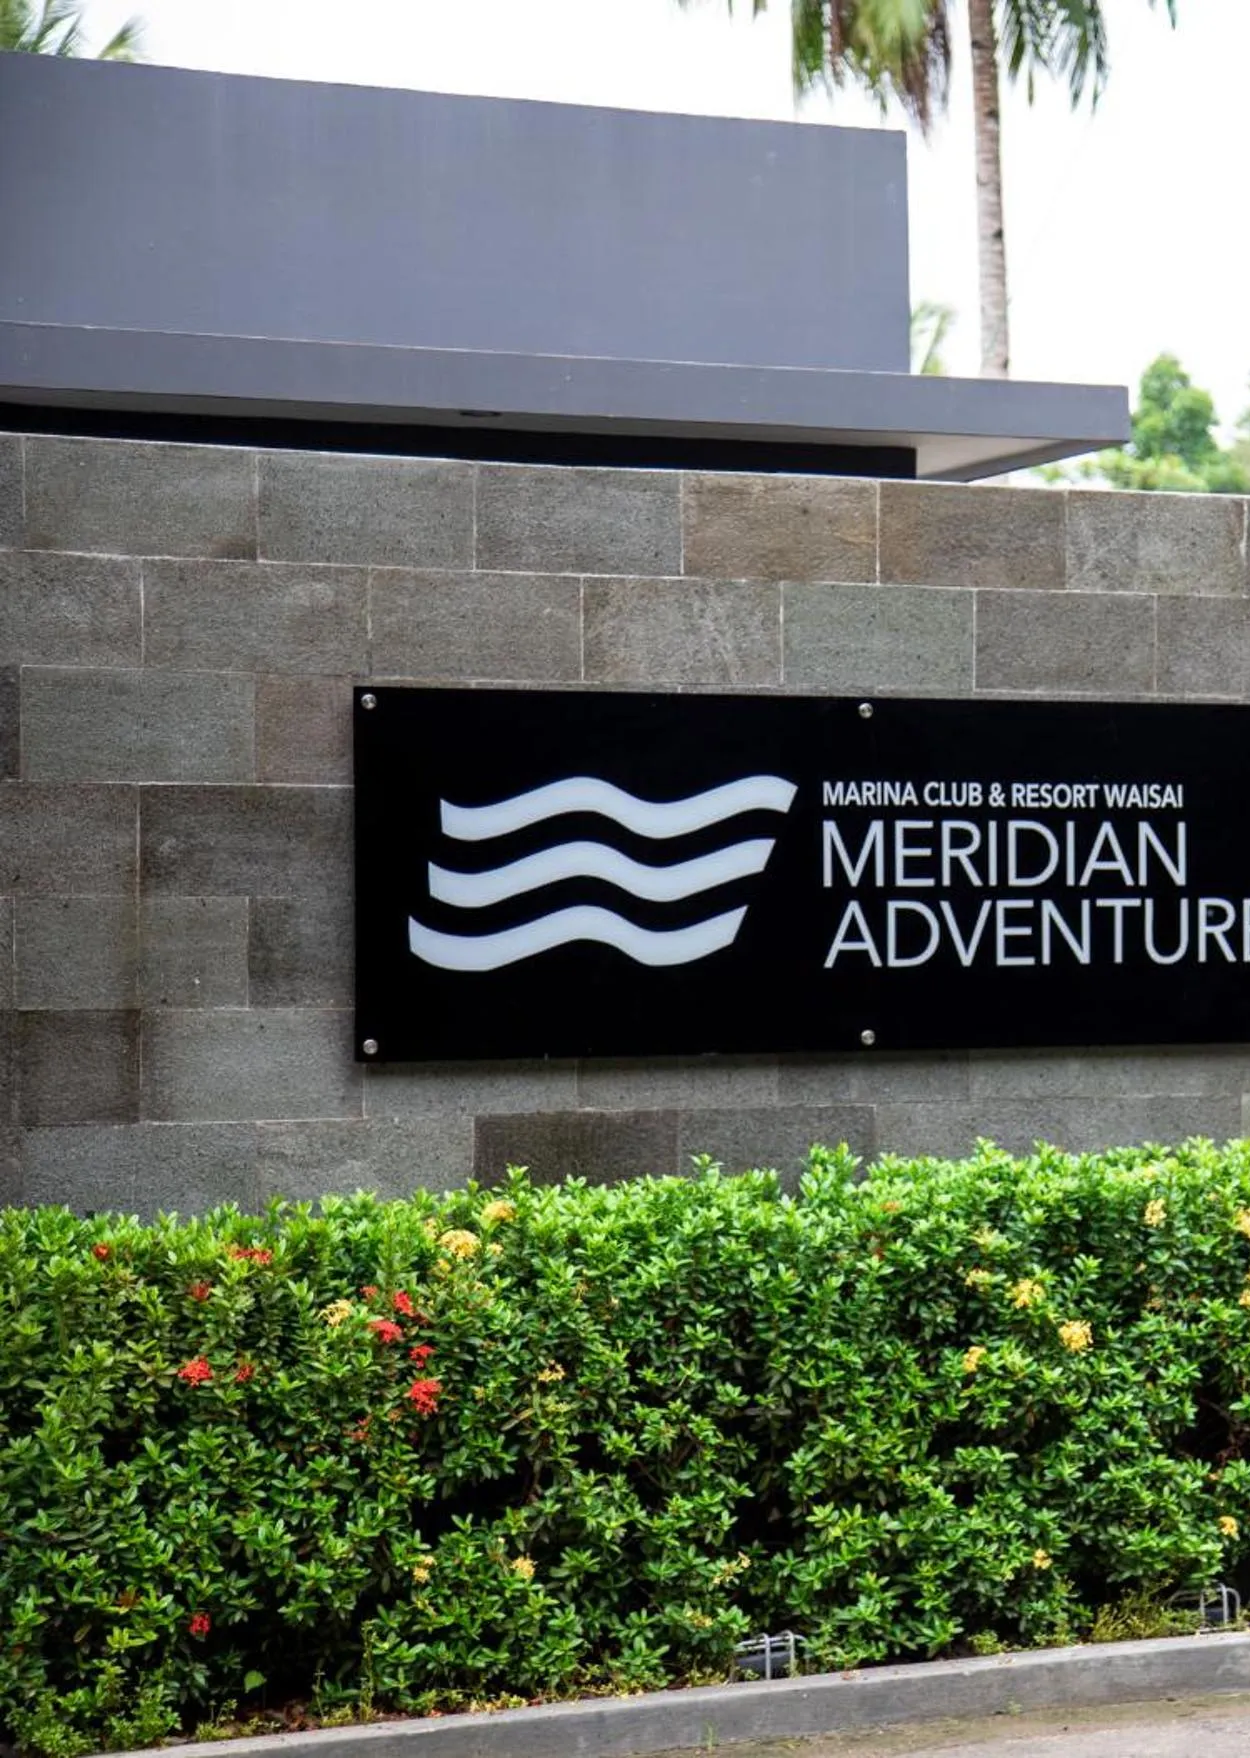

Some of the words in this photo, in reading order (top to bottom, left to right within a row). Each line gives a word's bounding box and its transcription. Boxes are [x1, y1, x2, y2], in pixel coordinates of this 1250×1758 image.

[823, 781, 918, 807] MARINA
[924, 781, 983, 808] CLUB
[989, 783, 1006, 808] &
[1011, 783, 1100, 809] RESORT
[1103, 784, 1184, 809] WAISAI
[822, 820, 1187, 888] MERIDIAN
